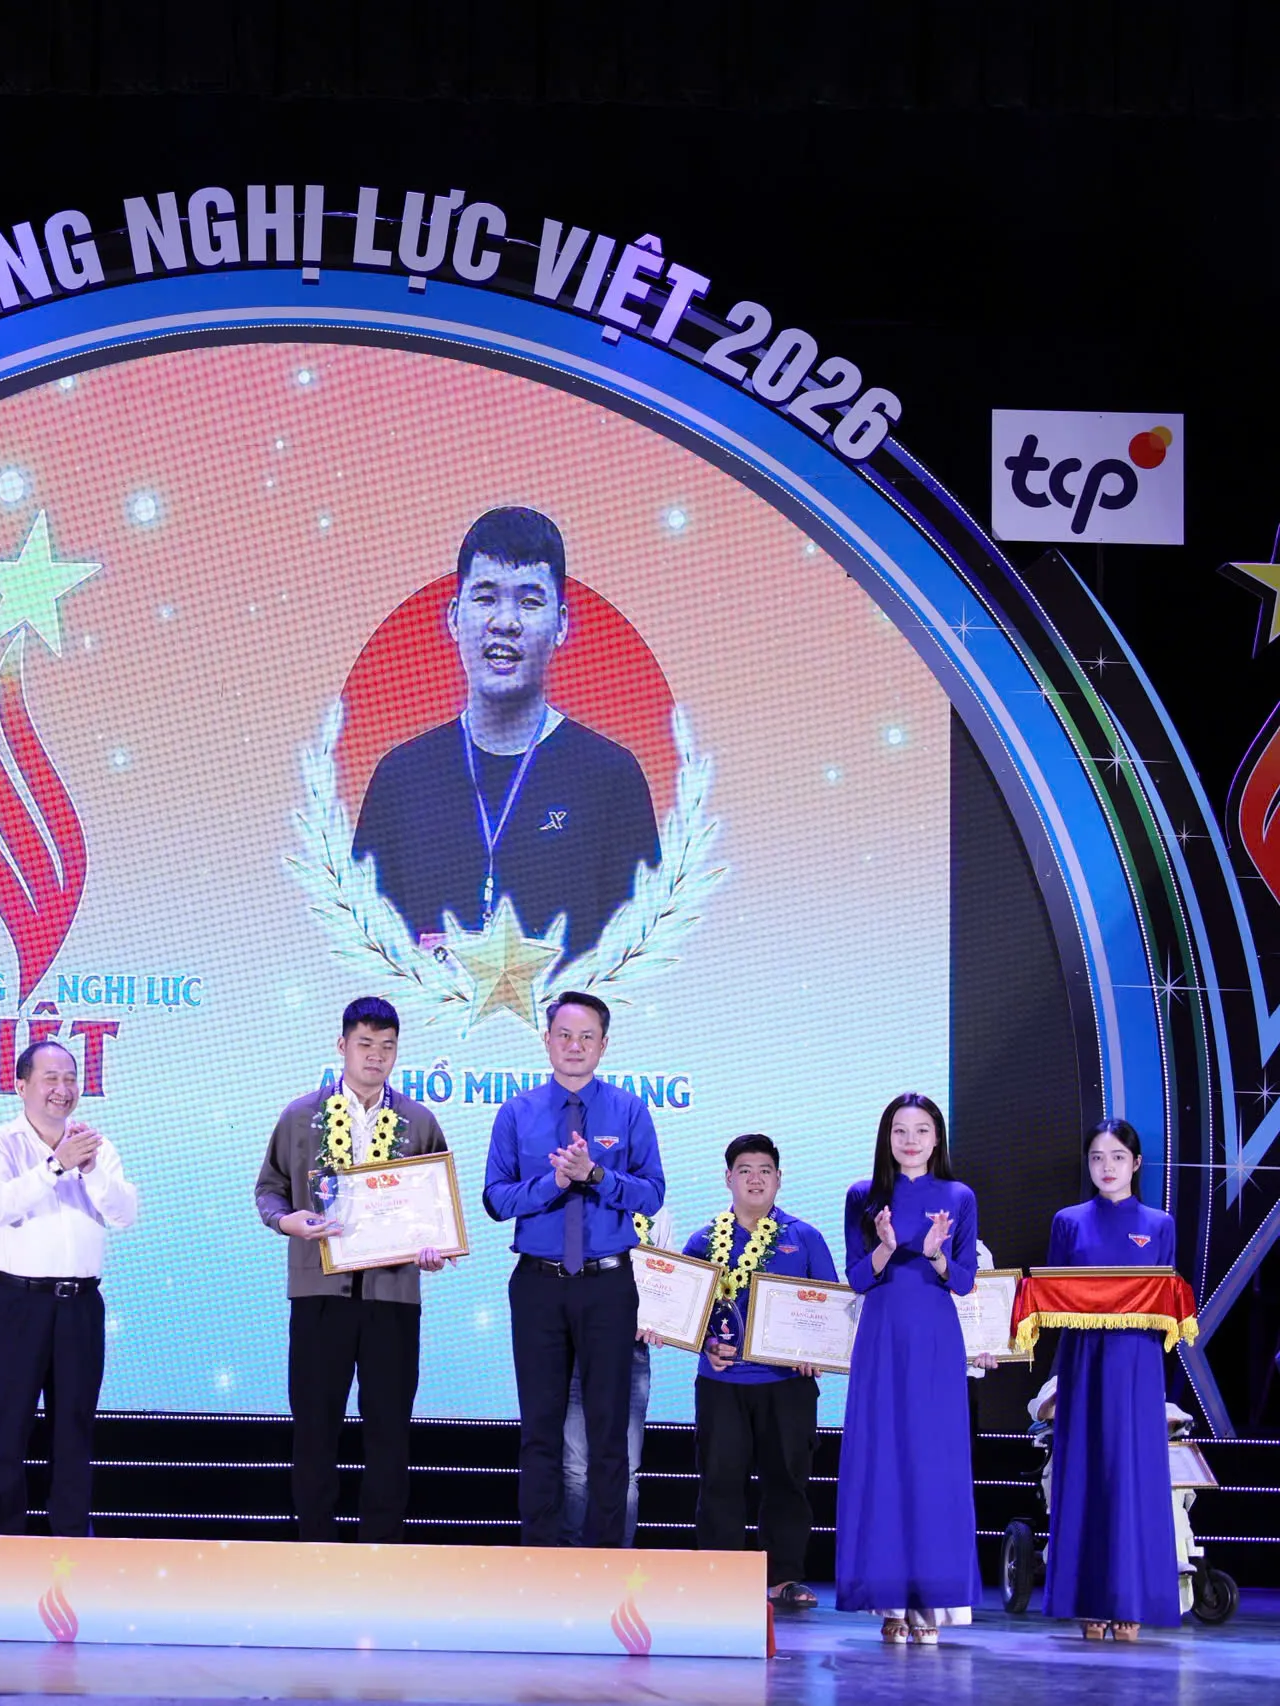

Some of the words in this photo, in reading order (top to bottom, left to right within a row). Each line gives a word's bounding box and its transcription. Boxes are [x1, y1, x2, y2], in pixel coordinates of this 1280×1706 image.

[123, 184, 324, 280] NGHỊ
[353, 186, 508, 290] LỰC
[533, 217, 710, 344] VIỆT
[703, 300, 903, 460] 2026
[1004, 434, 1139, 535] tcp
[57, 974, 136, 1012] NGHỊ
[146, 975, 202, 1013] LỰC
[402, 1059, 453, 1103] HỒ
